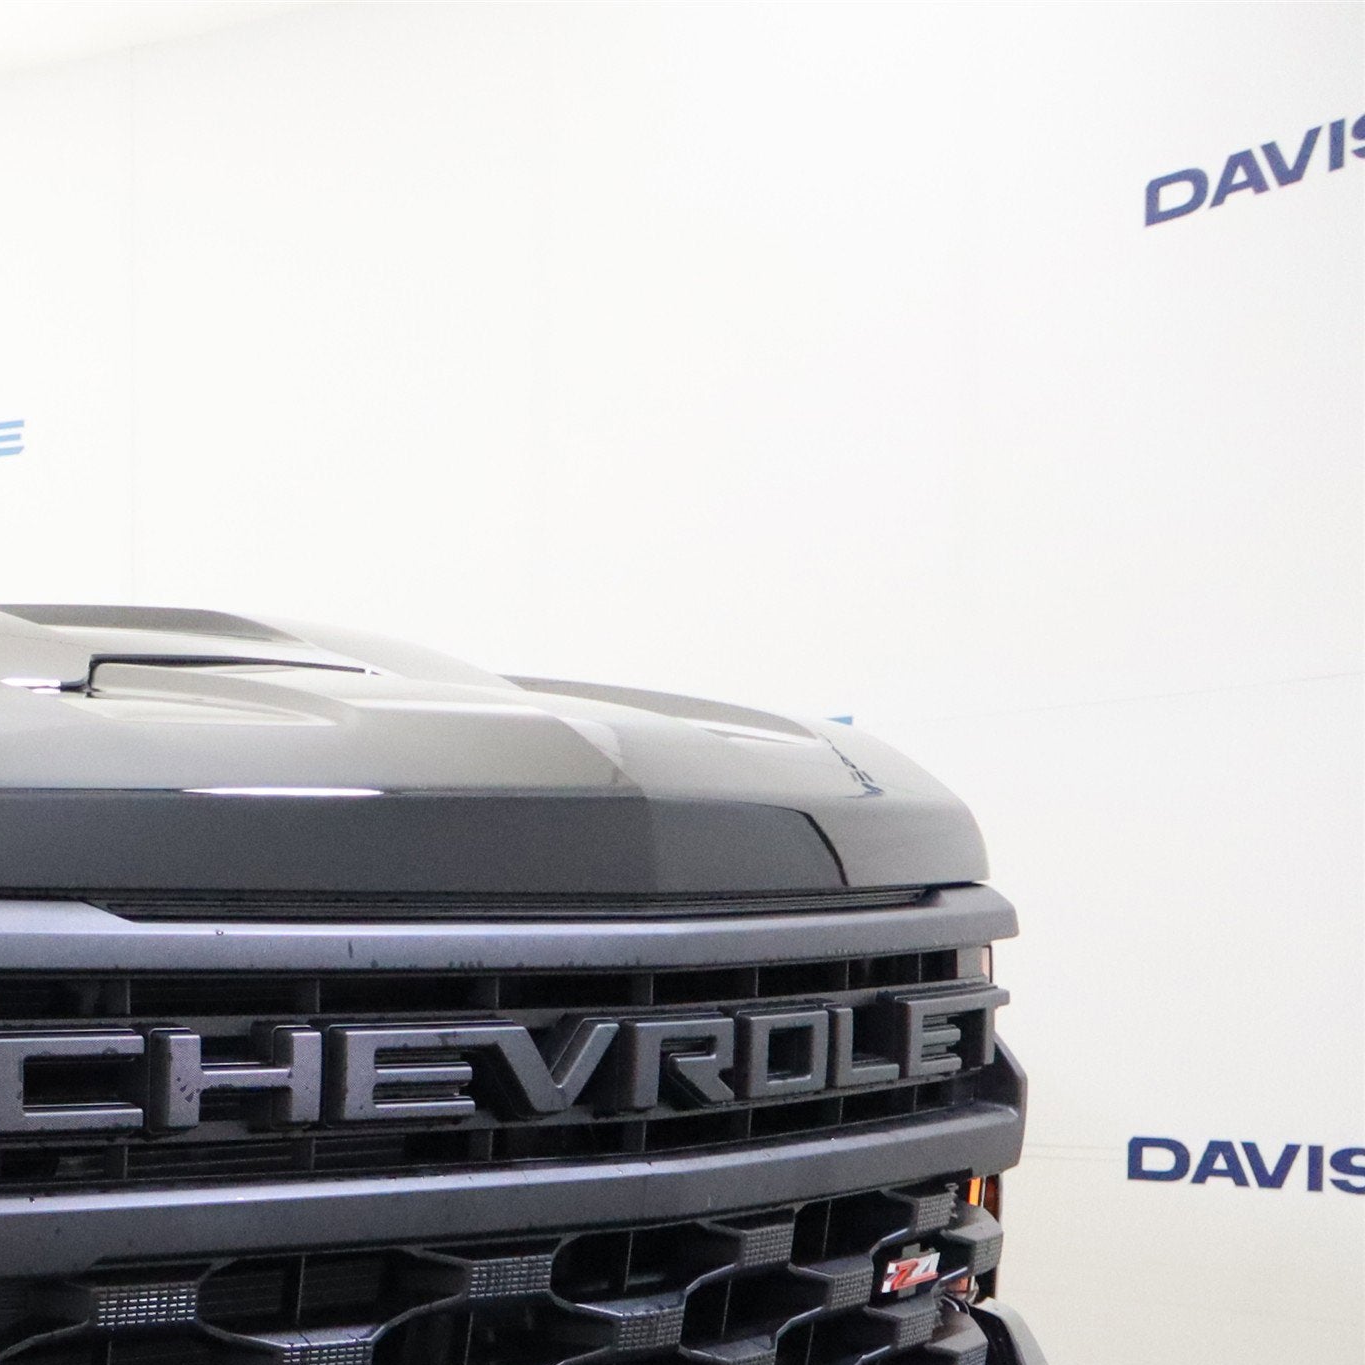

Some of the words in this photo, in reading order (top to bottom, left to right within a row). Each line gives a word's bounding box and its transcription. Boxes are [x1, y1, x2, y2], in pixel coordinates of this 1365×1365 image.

[1144, 114, 1365, 228] DAVI
[1127, 1136, 1365, 1196] DAVIS
[882, 1252, 941, 1293] Z71
